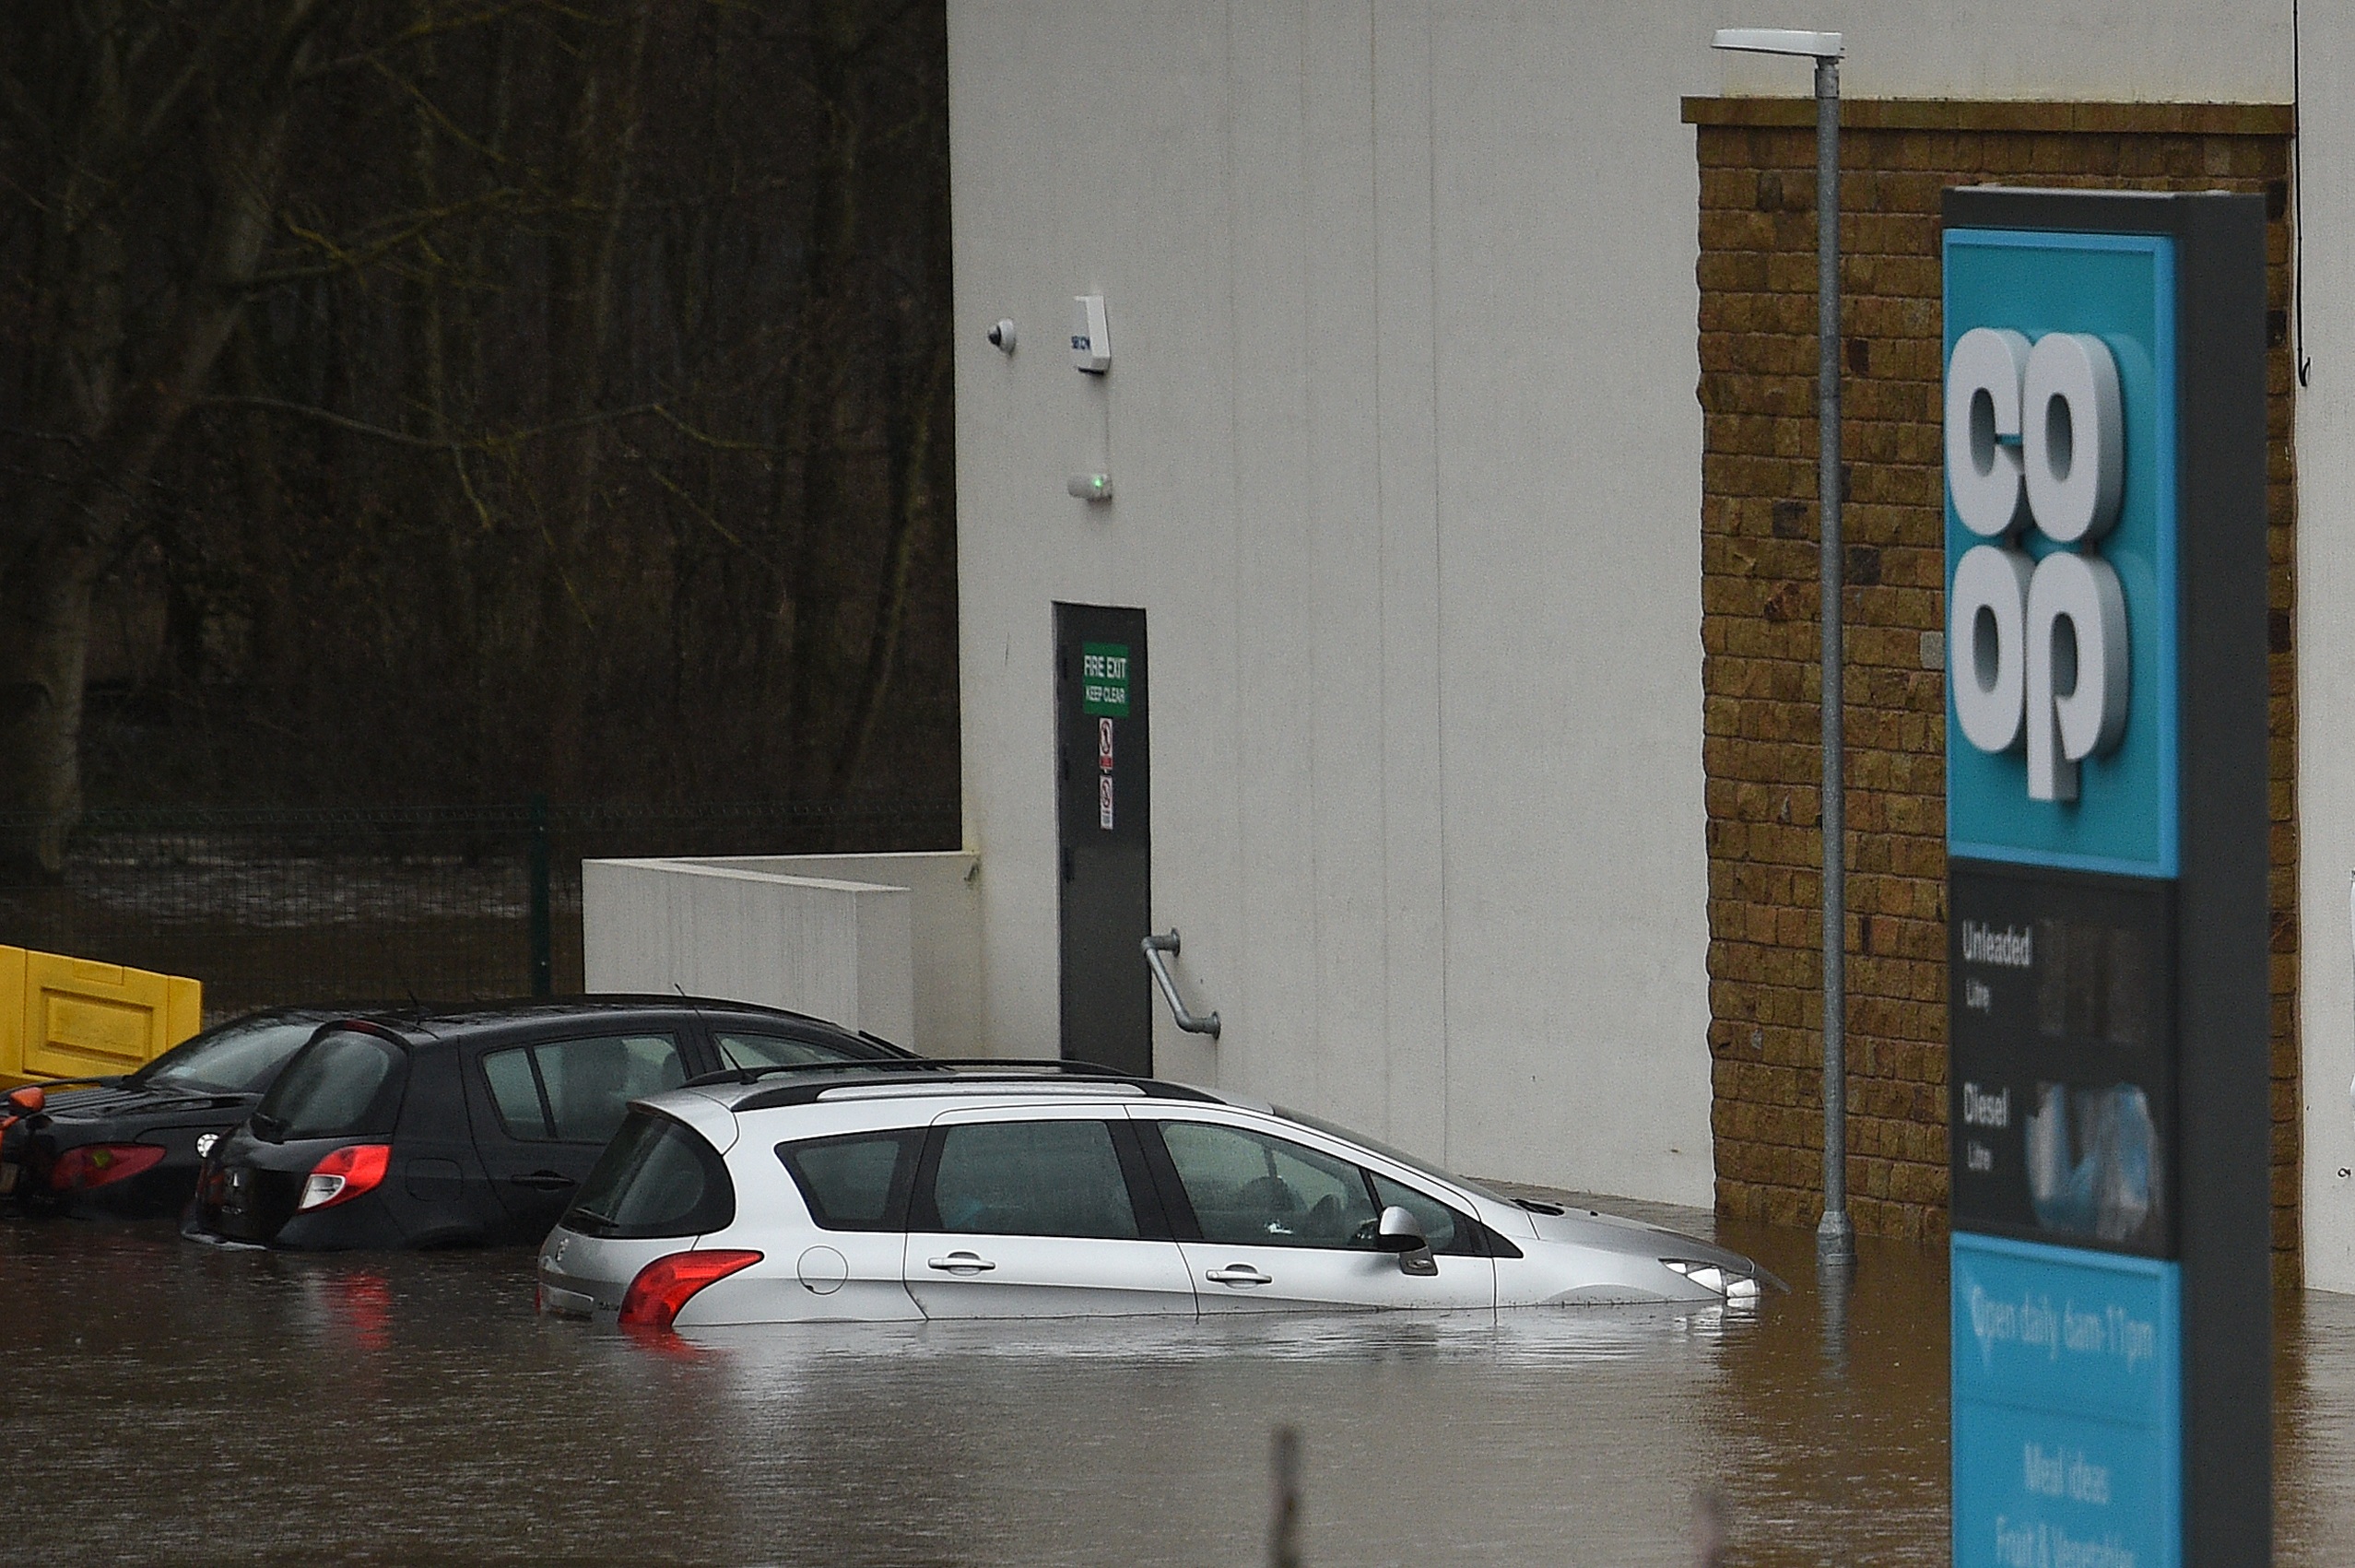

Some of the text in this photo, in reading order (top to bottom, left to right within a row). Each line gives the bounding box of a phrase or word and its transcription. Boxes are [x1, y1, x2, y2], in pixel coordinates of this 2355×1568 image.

[1084, 654, 1127, 678] FIRE EXIT
[1085, 685, 1125, 704] KEEP CLEAR
[1962, 919, 2032, 966] Unleaded
[1963, 1081, 2009, 1127] Diesel
[2021, 1292, 2058, 1362] daily
